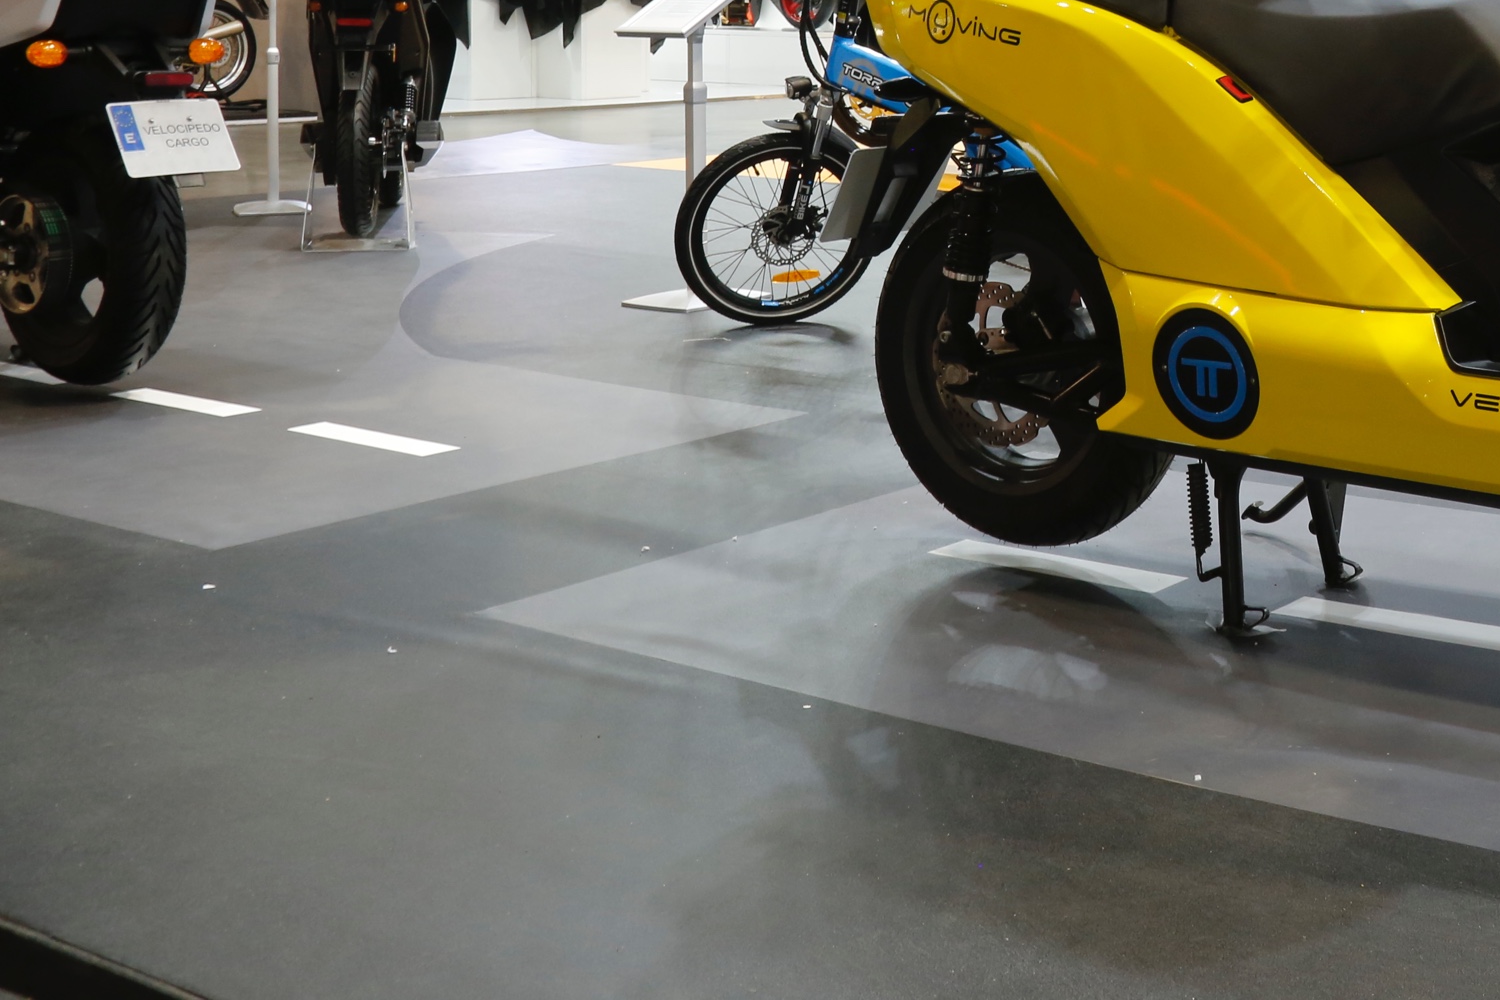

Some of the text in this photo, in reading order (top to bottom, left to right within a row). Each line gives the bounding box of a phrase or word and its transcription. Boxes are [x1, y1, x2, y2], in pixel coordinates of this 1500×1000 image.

[142, 123, 221, 135] VELOCIPEDO
[124, 133, 136, 143] E
[165, 137, 209, 148] CARGO
